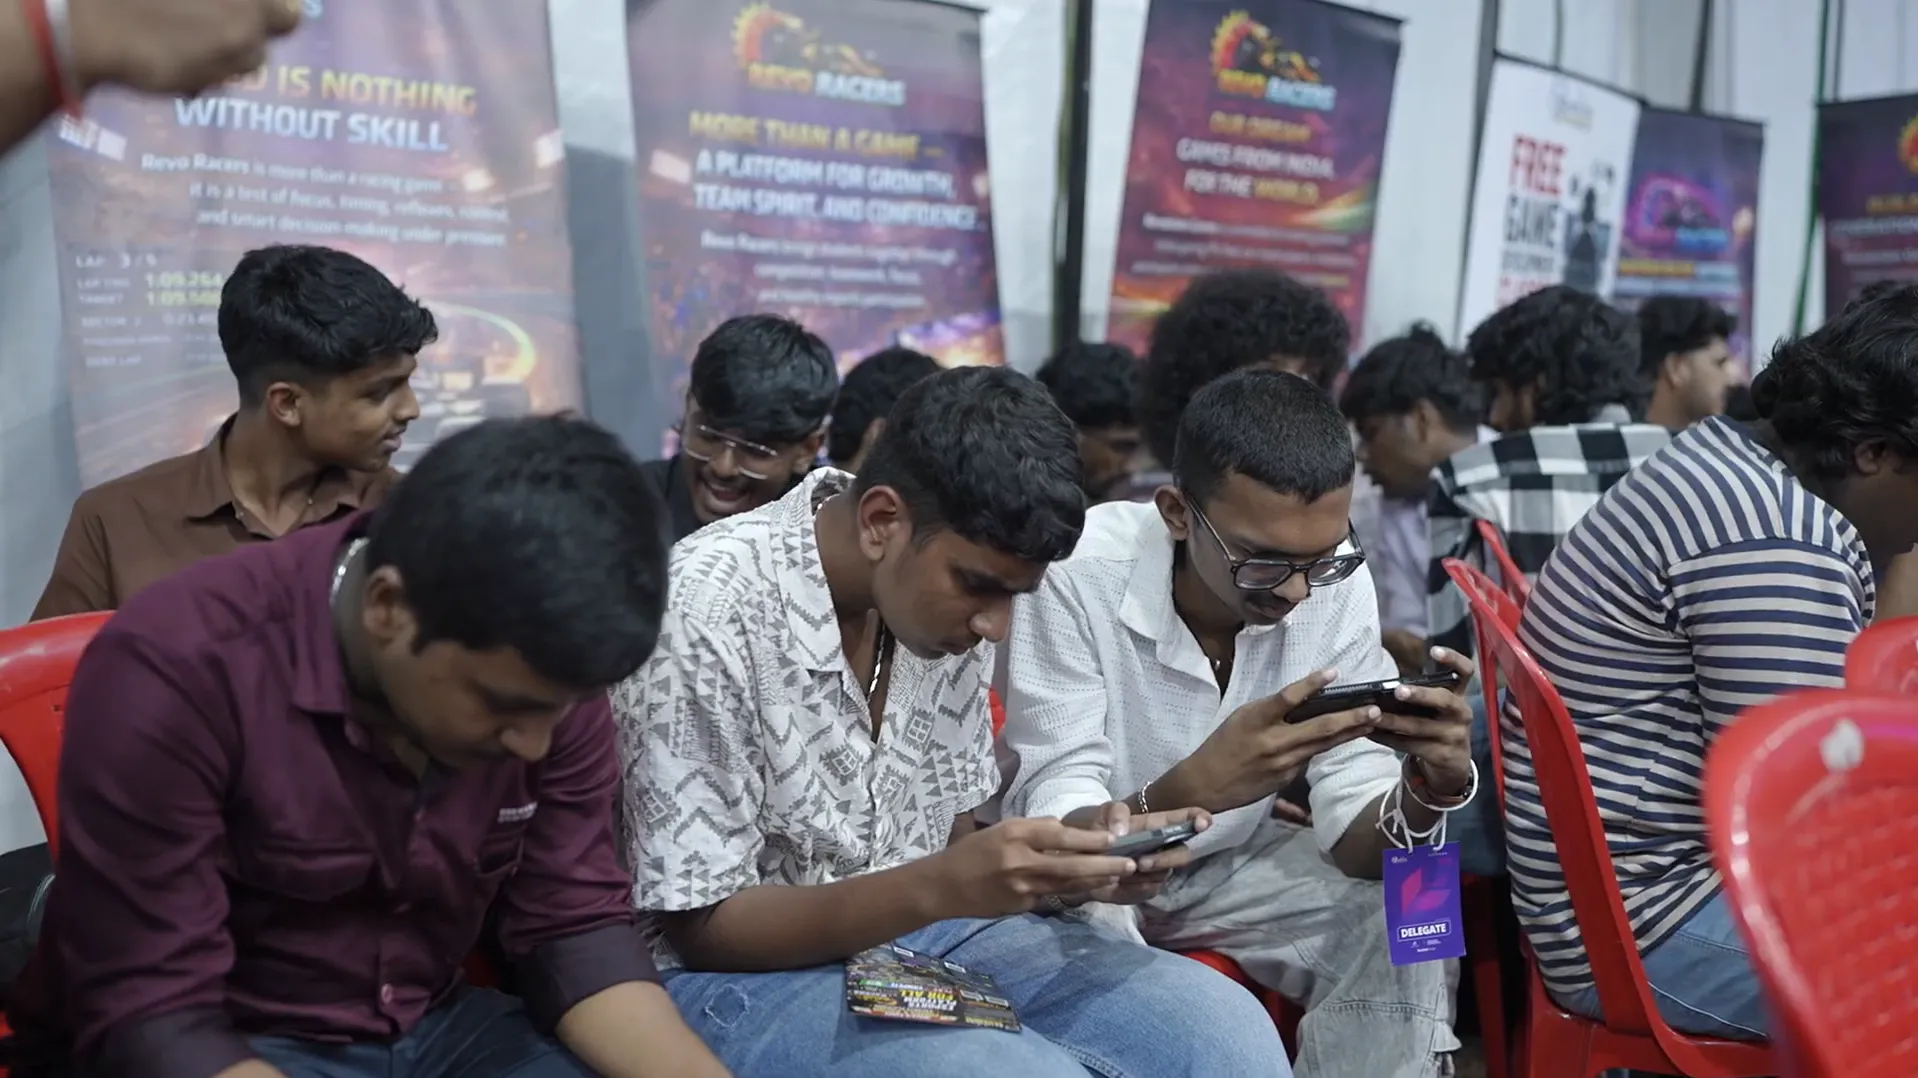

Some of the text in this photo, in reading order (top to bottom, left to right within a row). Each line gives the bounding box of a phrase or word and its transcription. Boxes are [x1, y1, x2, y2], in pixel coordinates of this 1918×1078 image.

[278, 64, 312, 97] IS
[321, 68, 477, 117] NOTHING
[814, 71, 906, 106] RACERS
[175, 97, 448, 151] WITHOUT SKILL
[689, 110, 758, 143] MORE
[764, 118, 831, 149] THAN
[834, 127, 850, 150] A
[854, 129, 920, 160] GAME
[141, 153, 190, 172] Revo
[193, 153, 249, 174] Racers
[696, 149, 713, 173] A
[715, 150, 823, 185] PLATFORM
[826, 161, 865, 189] FOR
[1175, 136, 1232, 167] GAMES
[1511, 133, 1566, 199] FREE
[694, 183, 751, 210] TEAM
[823, 196, 865, 221] AND
[1400, 923, 1447, 938] DELEGATE
[900, 989, 924, 998] ALL
[904, 997, 957, 1006] PLATFORM
[927, 990, 954, 1001] FOR
